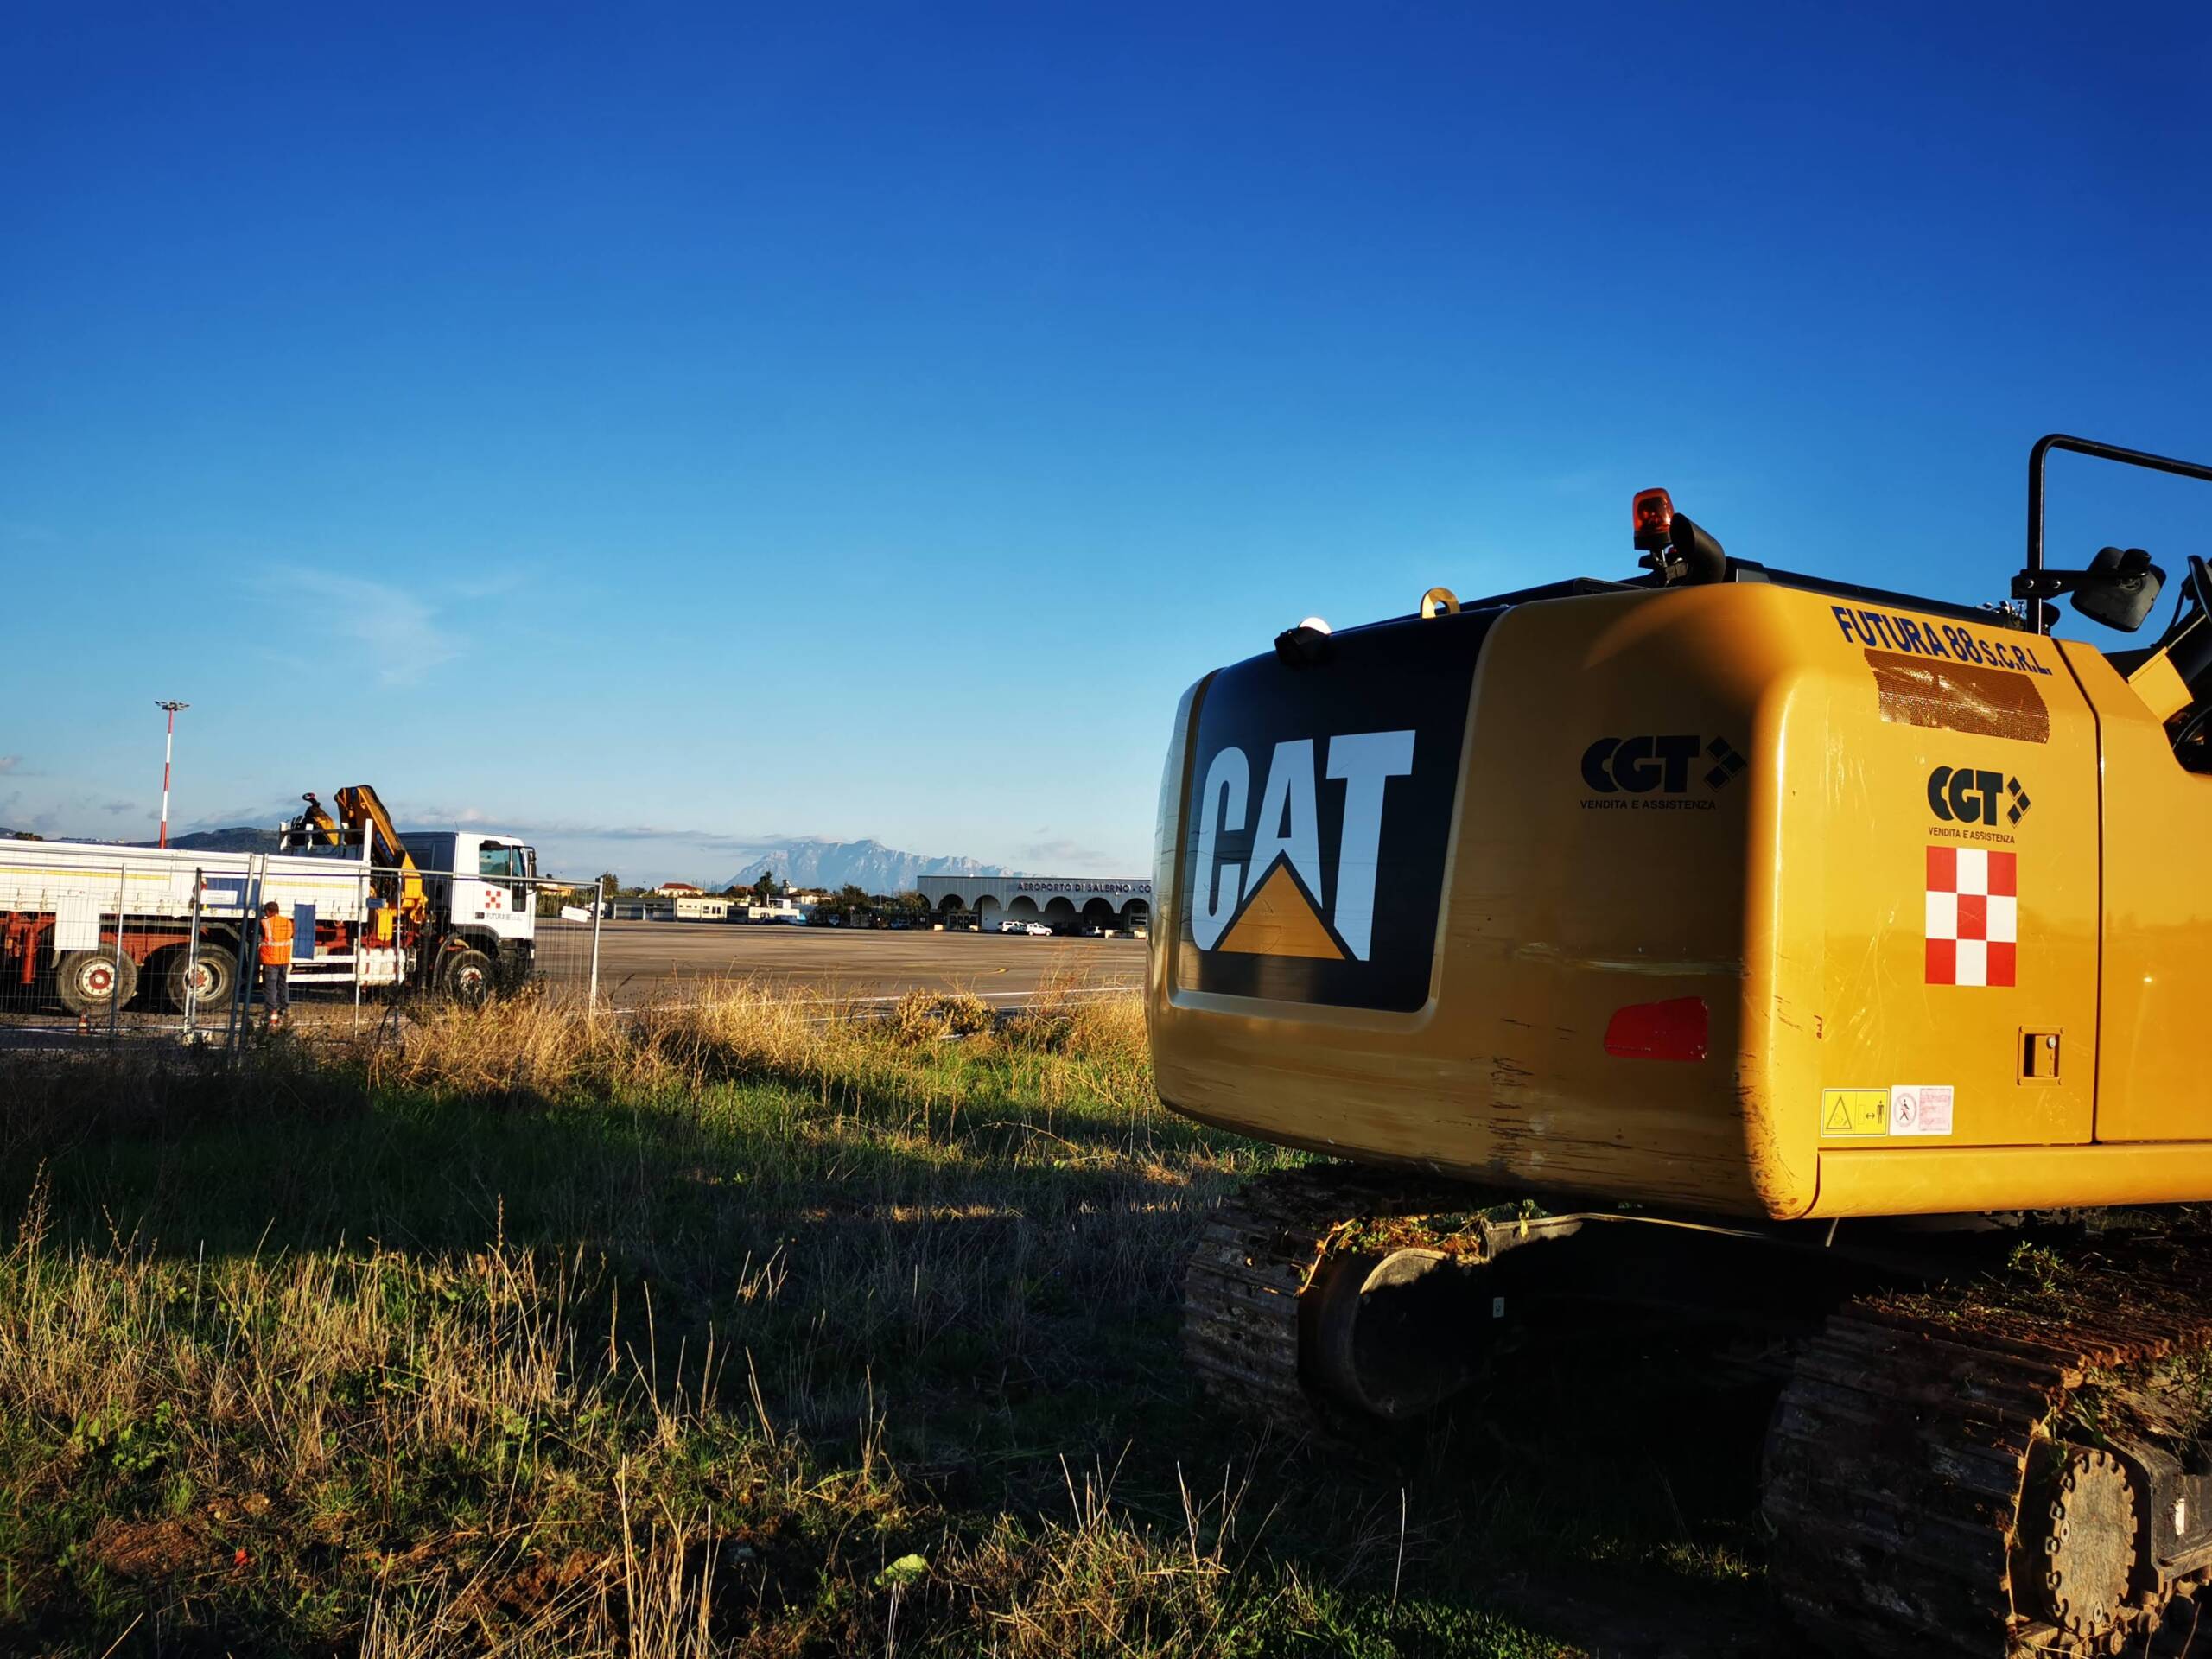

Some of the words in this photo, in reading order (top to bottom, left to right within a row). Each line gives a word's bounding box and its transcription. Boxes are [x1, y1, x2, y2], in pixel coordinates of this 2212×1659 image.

[1830, 606, 1951, 658] FUTURA
[1942, 625, 1983, 664] 88
[1979, 639, 2052, 675] S.C.R.L.
[1581, 735, 1700, 793] CGT
[1580, 799, 1628, 810] VENDITA
[1631, 800, 1639, 809] E
[1642, 800, 1717, 810] ASSISTENZA
[1927, 766, 2004, 826] CGT
[1192, 730, 1415, 962] CAT
[1929, 827, 1961, 838] VENDITA
[1970, 831, 2016, 844] ASSISTENZA
[1017, 882, 1072, 892] AEROPORTO
[1075, 883, 1084, 893] DI
[1087, 883, 1130, 893] SALERNO
